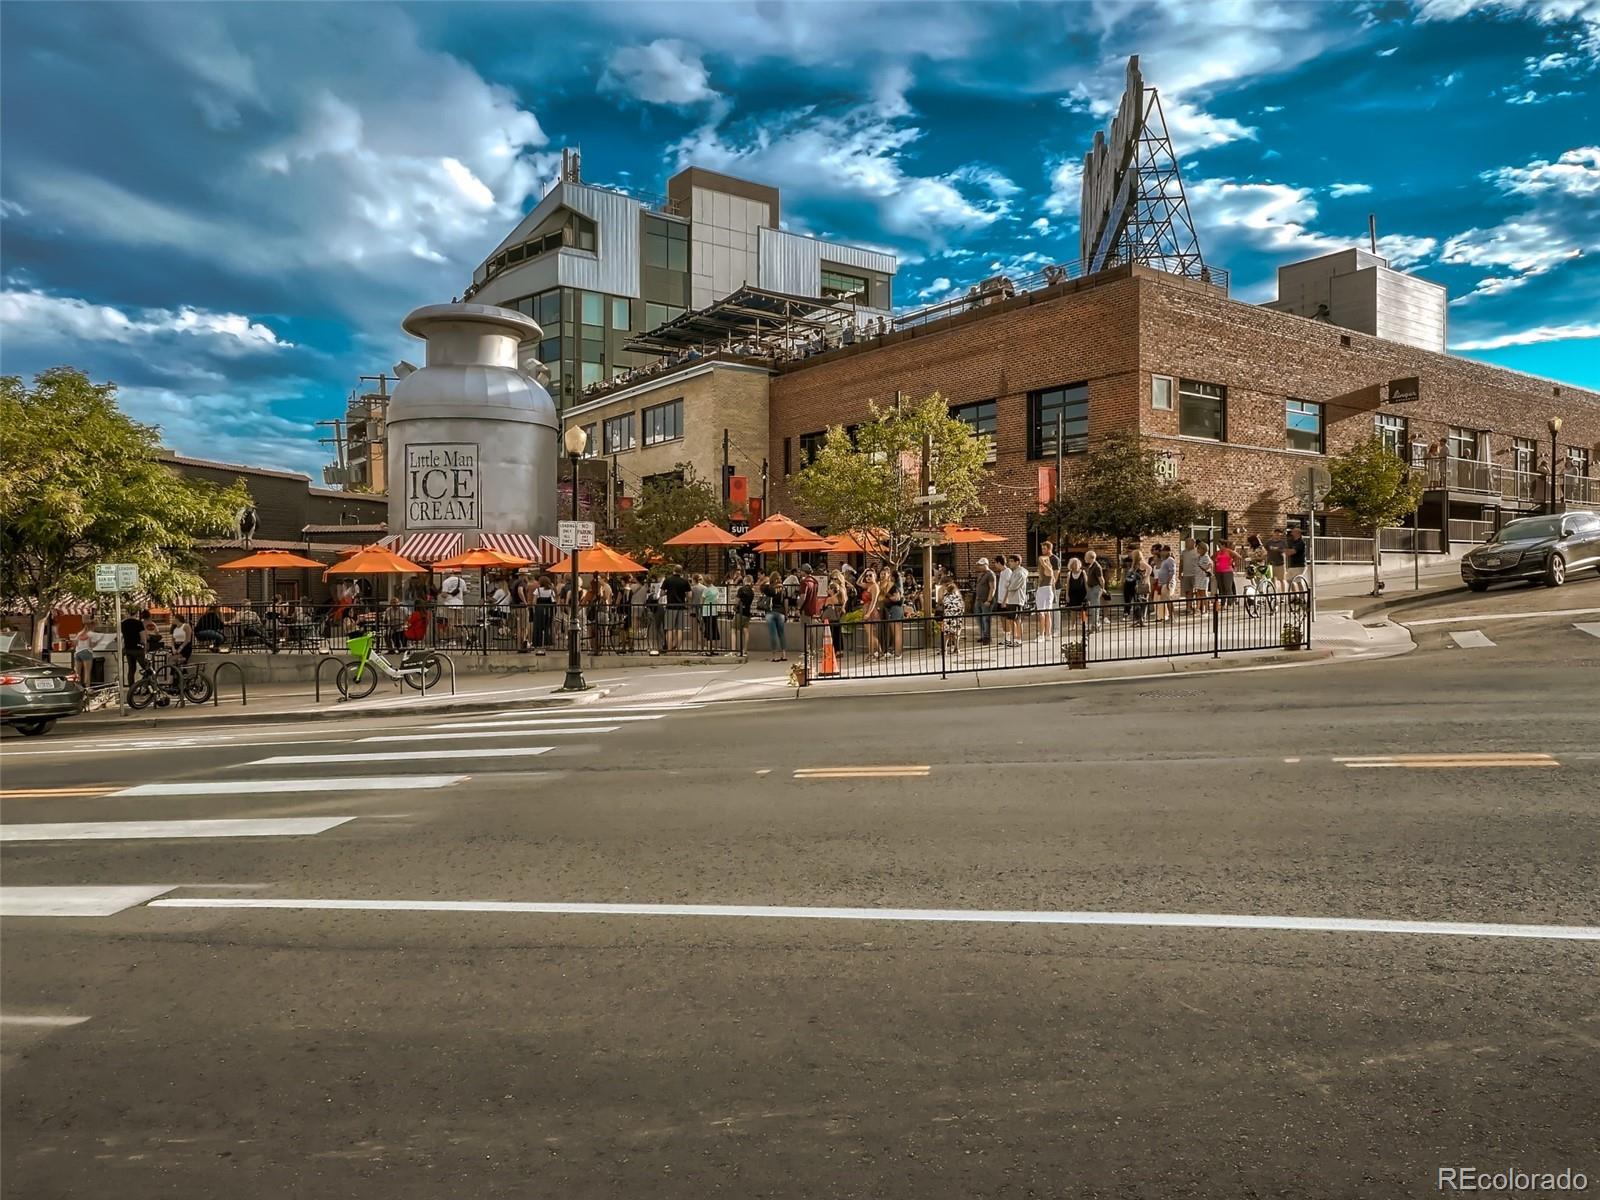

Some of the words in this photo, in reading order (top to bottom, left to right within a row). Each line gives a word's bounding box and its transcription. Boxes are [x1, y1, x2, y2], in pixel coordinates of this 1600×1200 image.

[410, 450, 440, 468] Little
[444, 450, 473, 467] Man
[410, 469, 474, 499] ICE
[410, 501, 475, 521] CREAM
